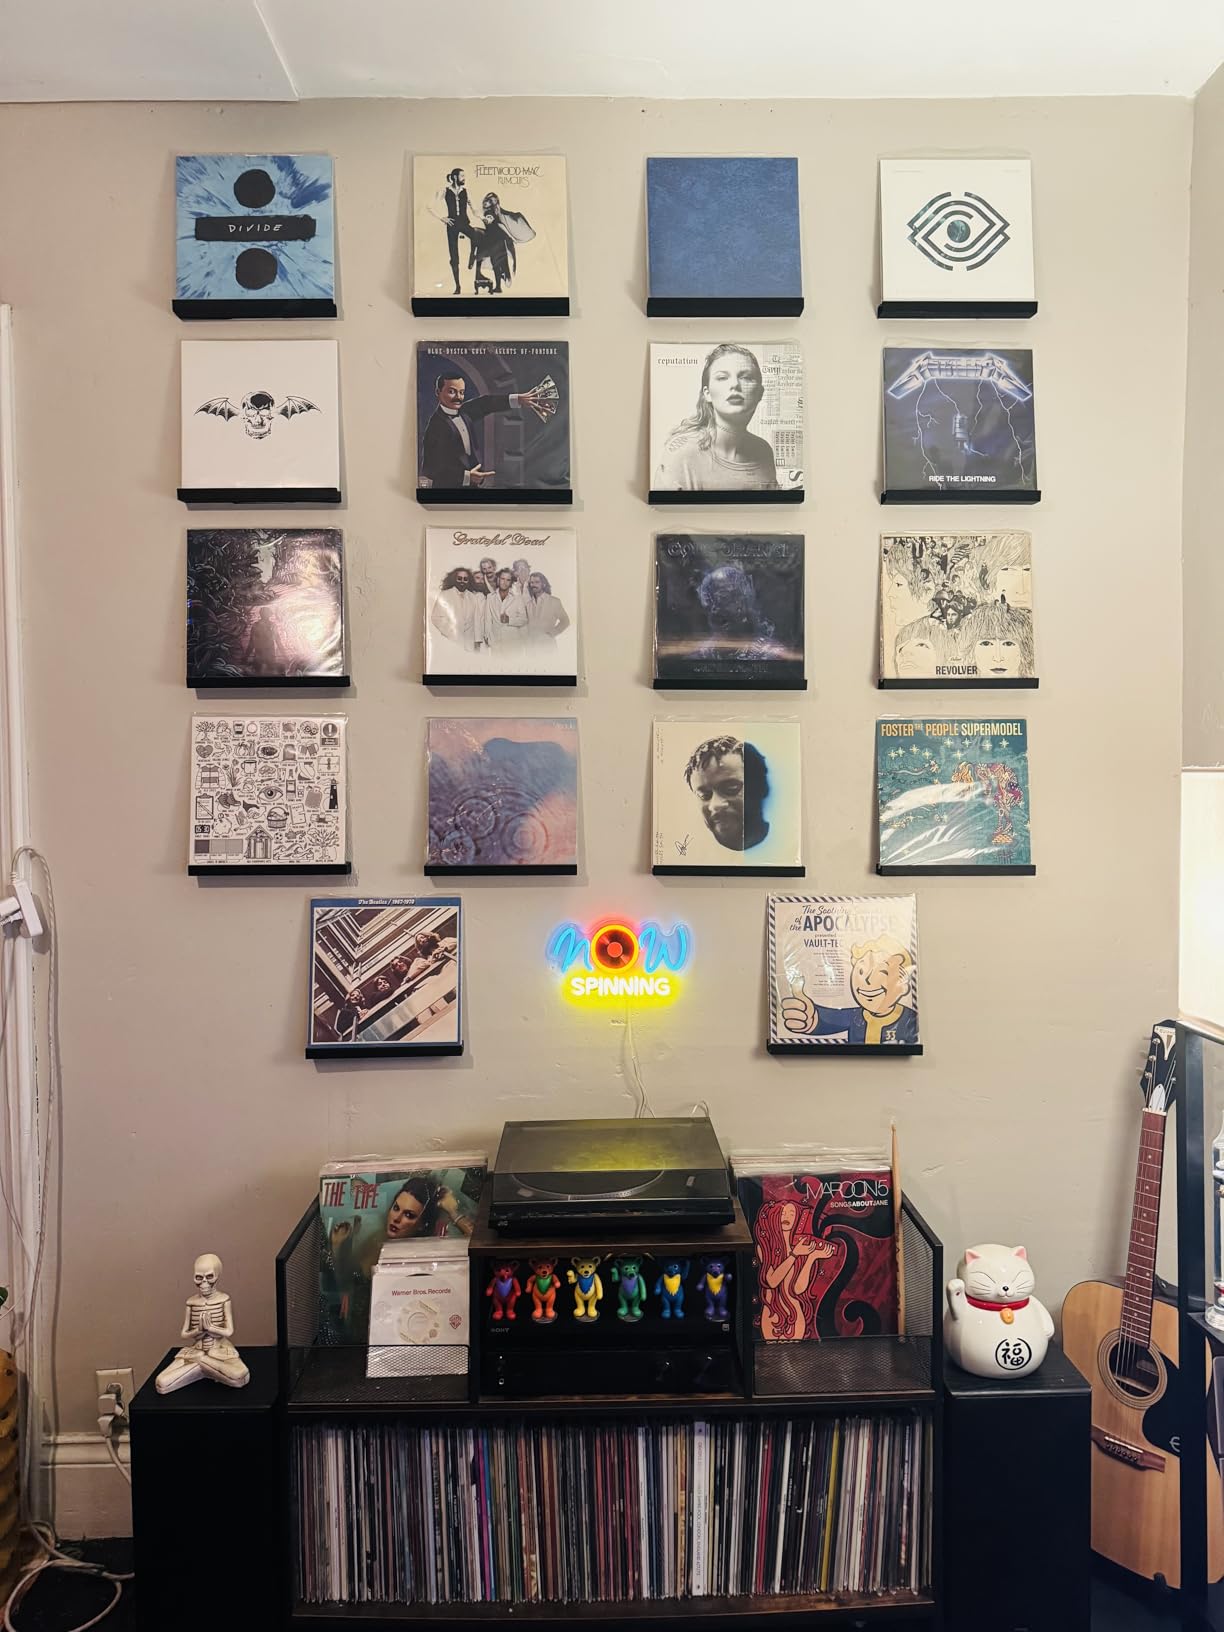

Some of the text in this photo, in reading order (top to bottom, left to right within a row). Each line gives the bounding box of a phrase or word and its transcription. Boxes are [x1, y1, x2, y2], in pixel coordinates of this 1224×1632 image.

[522, 166, 544, 177] MAC
[228, 224, 282, 232] DIVIDE
[657, 358, 698, 366] reputation
[960, 475, 996, 483] LIGHTNING
[452, 531, 551, 547] Grateful Dead
[935, 665, 978, 675] REVOLVER
[881, 723, 914, 736] FOSTER
[925, 723, 959, 736] PEOPLE
[960, 722, 1023, 736] SUPERMODEL
[802, 905, 816, 914] The
[794, 916, 802, 925] of
[789, 923, 801, 932] the
[570, 975, 672, 997] SPINNING
[324, 1181, 348, 1208] THE
[392, 1289, 412, 1297] Warner
[428, 1287, 451, 1295] Records
[1001, 1342, 1025, 1366] 福
